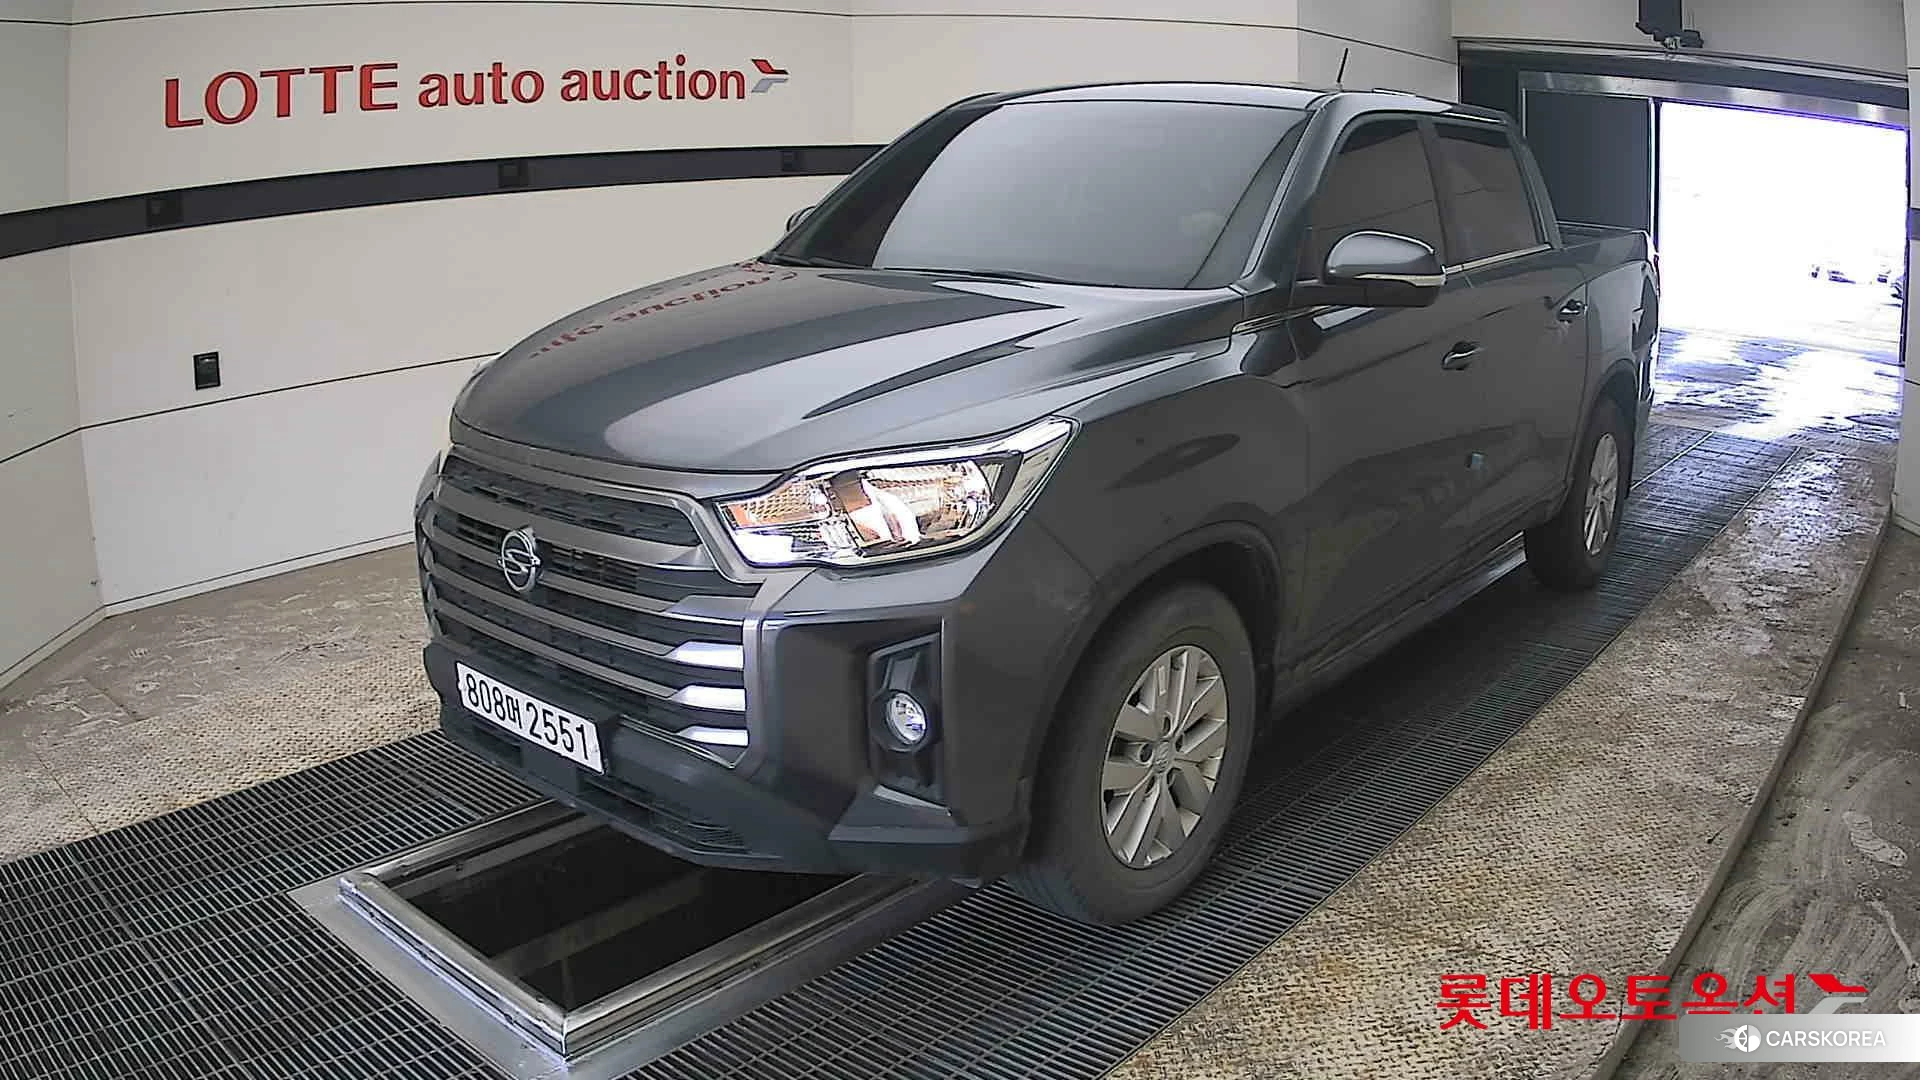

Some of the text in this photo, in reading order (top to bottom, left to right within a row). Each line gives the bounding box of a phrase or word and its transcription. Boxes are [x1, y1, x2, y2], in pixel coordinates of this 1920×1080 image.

[164, 55, 748, 129] LOTTE auto auction
[466, 673, 589, 761] 808머 2551
